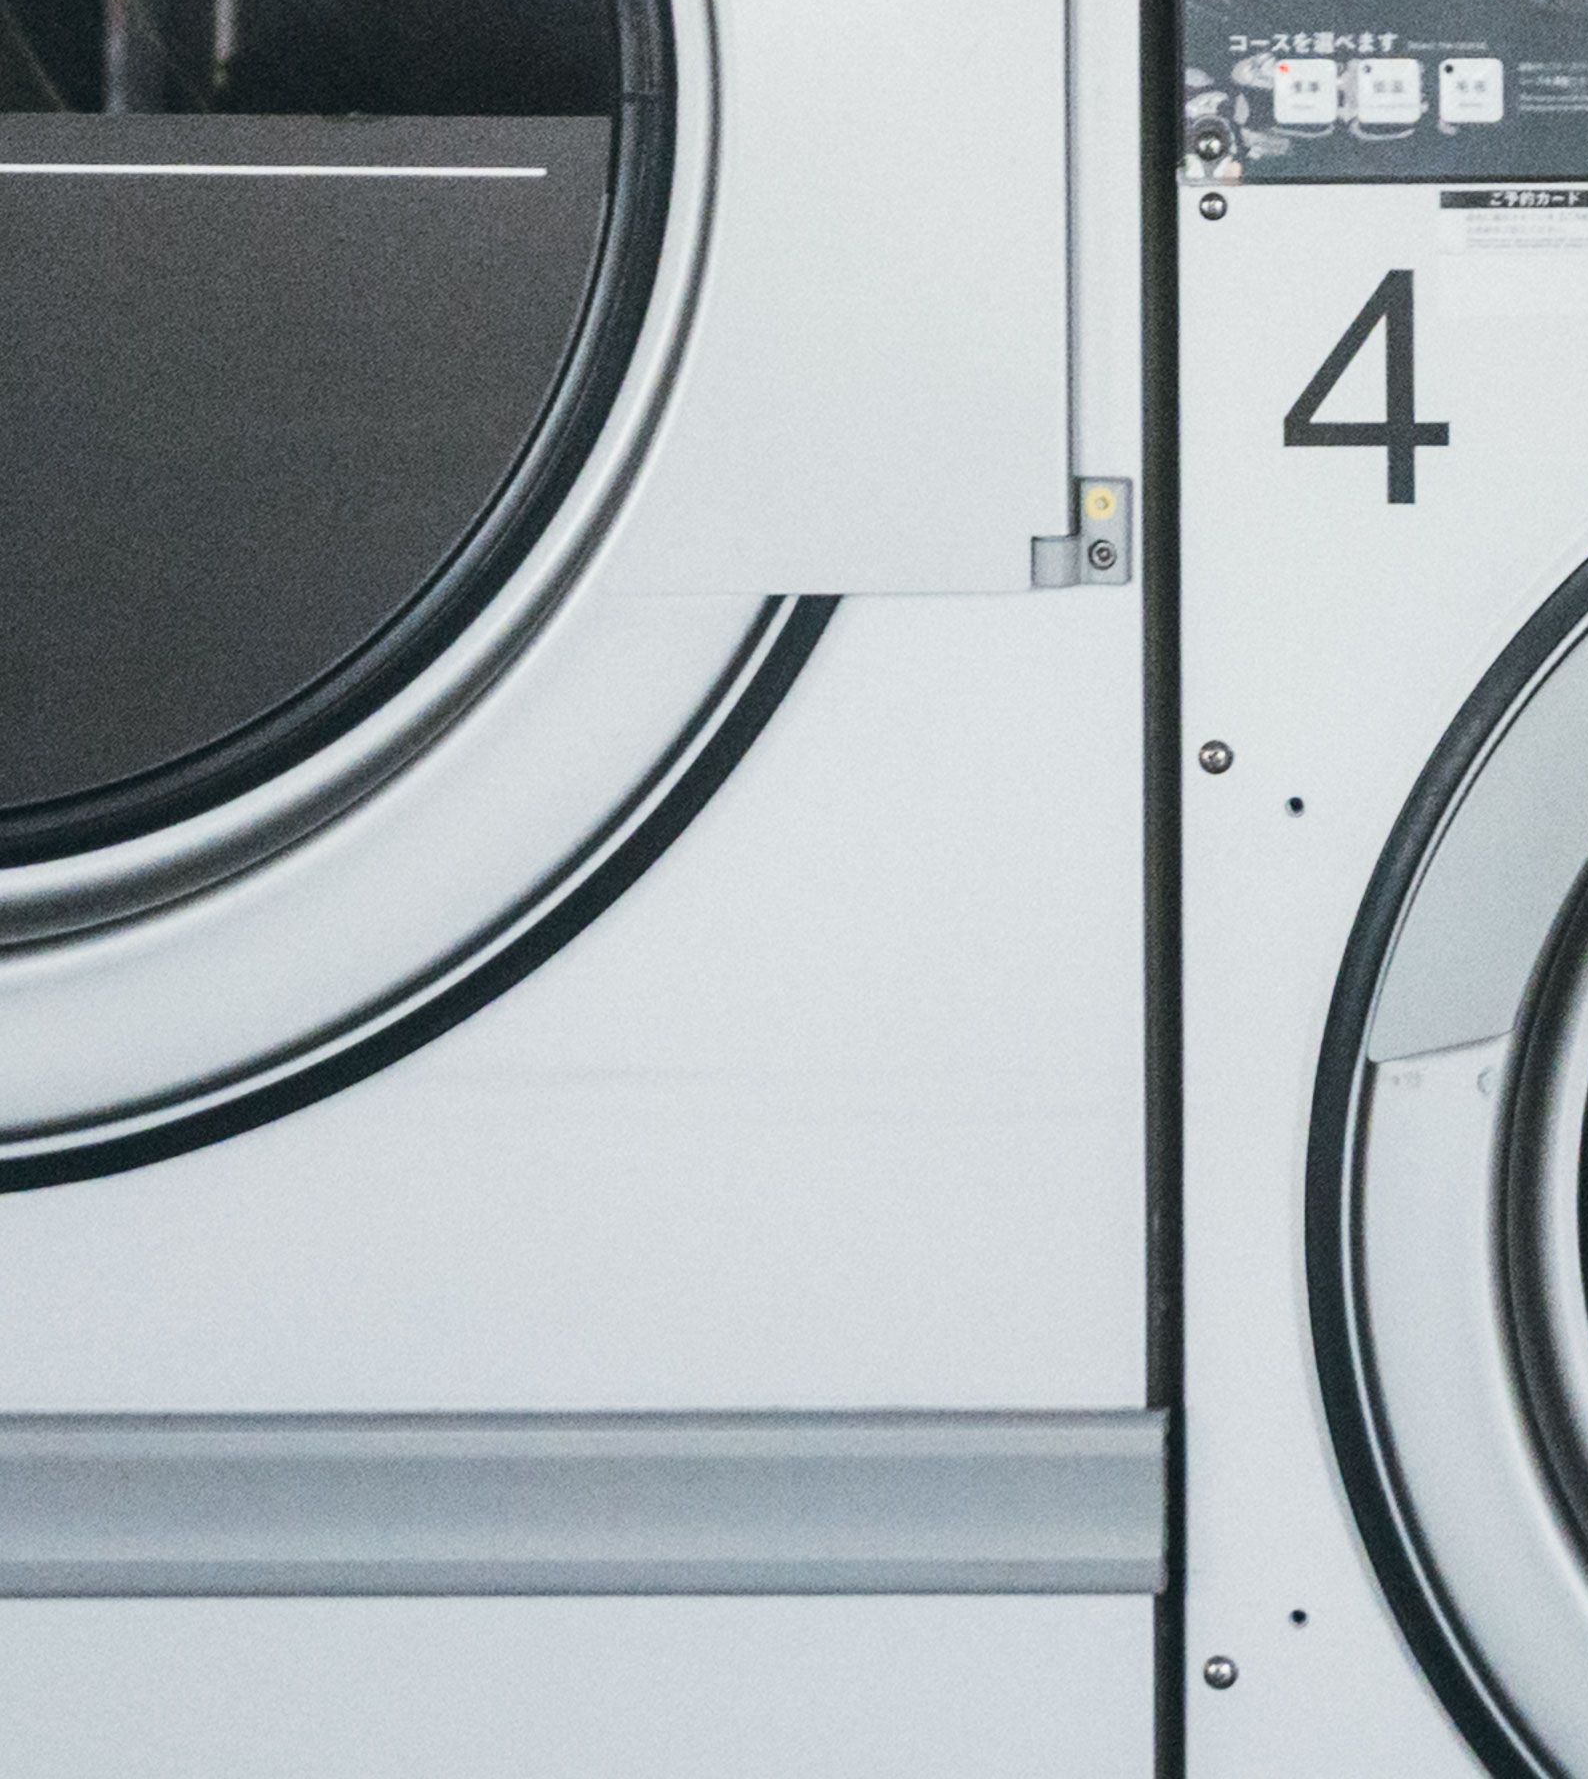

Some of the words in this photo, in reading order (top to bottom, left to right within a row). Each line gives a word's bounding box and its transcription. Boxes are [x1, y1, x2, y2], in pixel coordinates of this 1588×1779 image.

[1231, 32, 1396, 55] コースを選べます
[1283, 270, 1449, 504] 4
